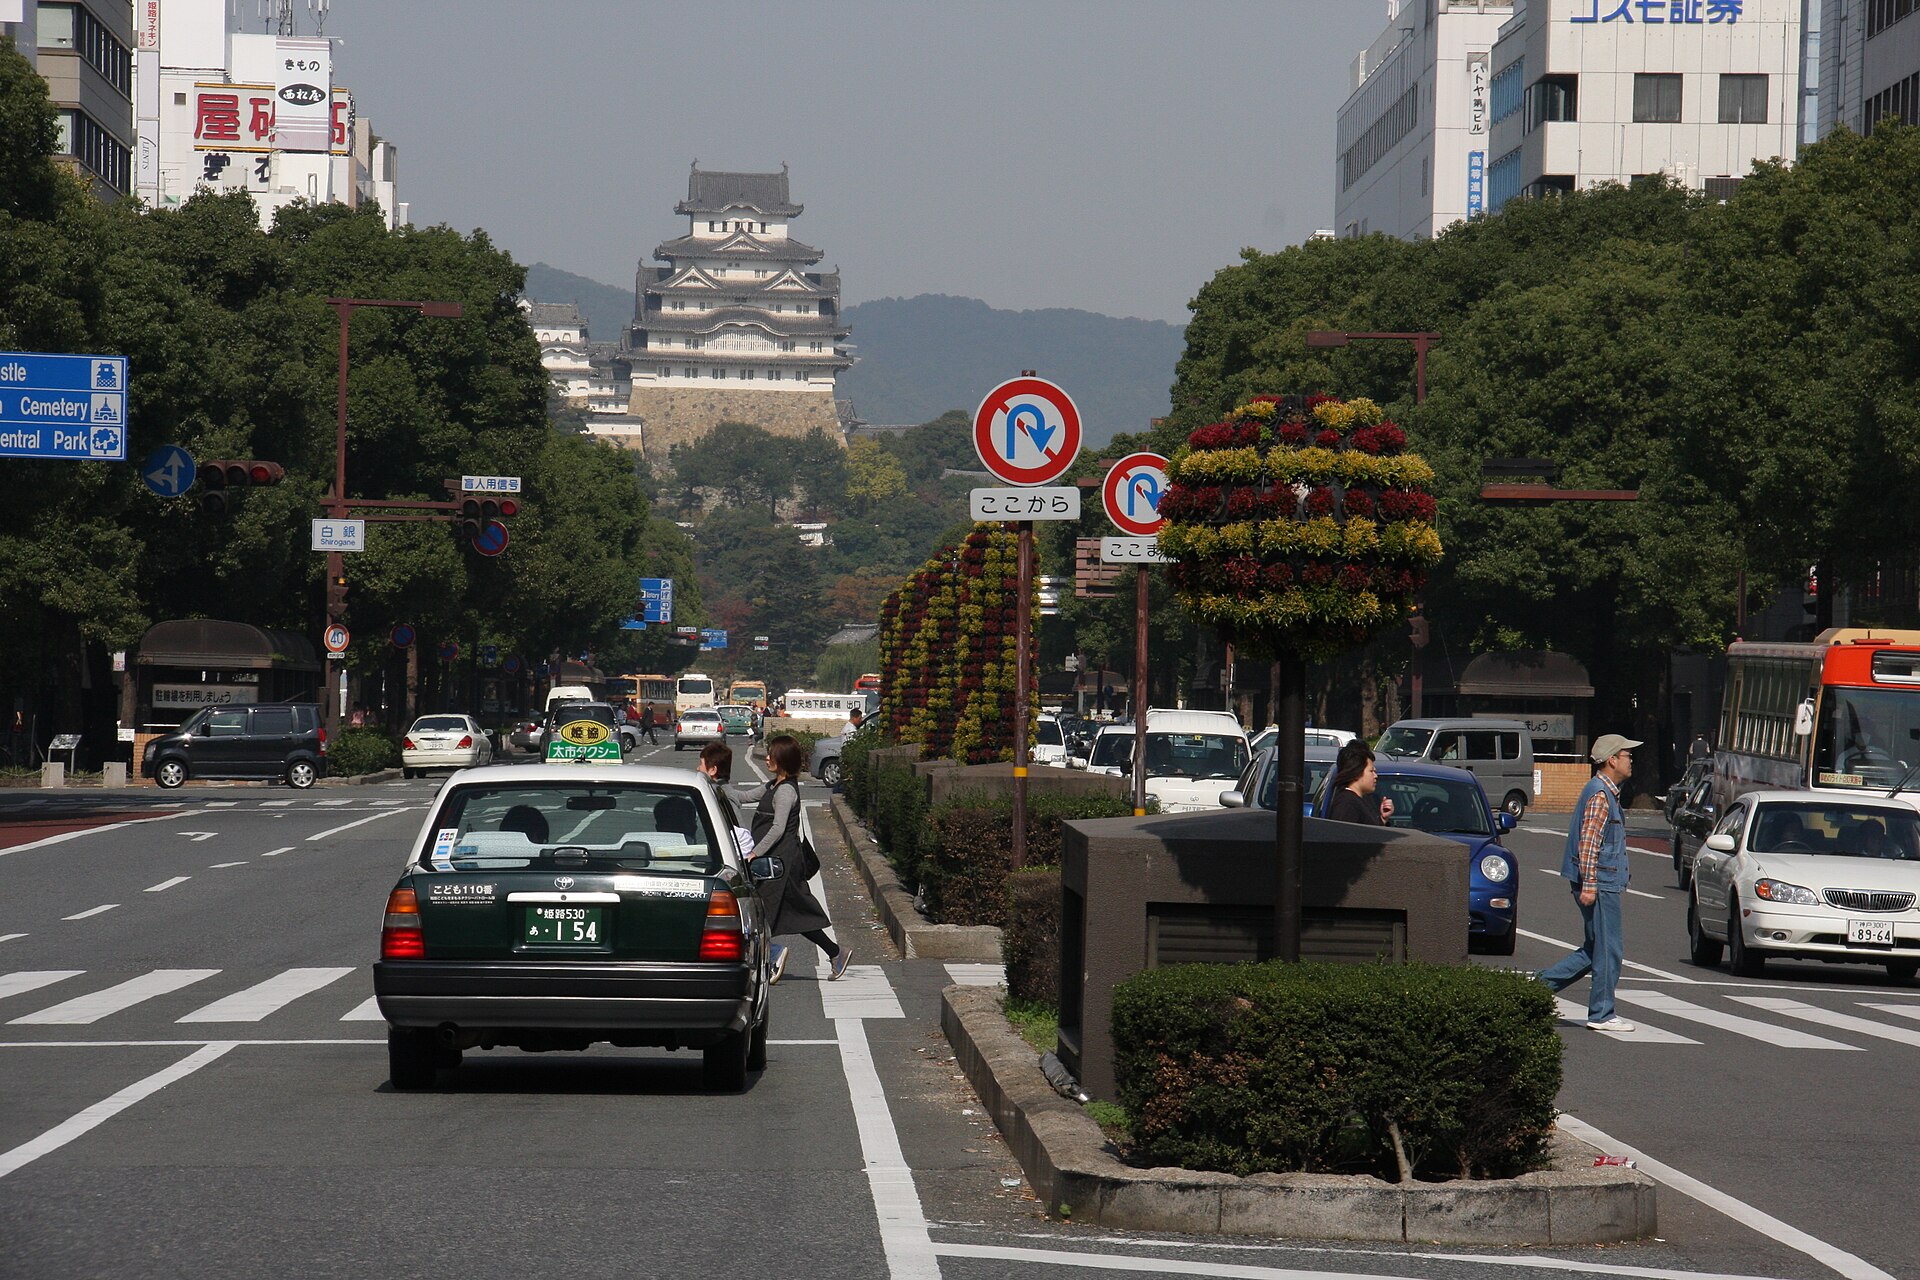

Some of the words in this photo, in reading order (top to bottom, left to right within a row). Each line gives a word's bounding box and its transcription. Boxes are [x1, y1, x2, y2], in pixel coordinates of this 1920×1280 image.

[284, 58, 320, 72] きもの
[282, 88, 322, 102] 西松屋
[1472, 65, 1484, 132] ハトヤ第一ビル
[20, 396, 88, 421] Cemetery
[53, 431, 88, 451] Park
[981, 495, 1069, 514] ここから
[320, 538, 356, 547] Shirogane
[1110, 543, 1162, 558] ここま
[330, 631, 344, 645] 40
[552, 745, 618, 758] 太市タクシー
[433, 885, 493, 895] こども110番
[529, 925, 539, 936] あ
[1857, 929, 1891, 942] 89-64
